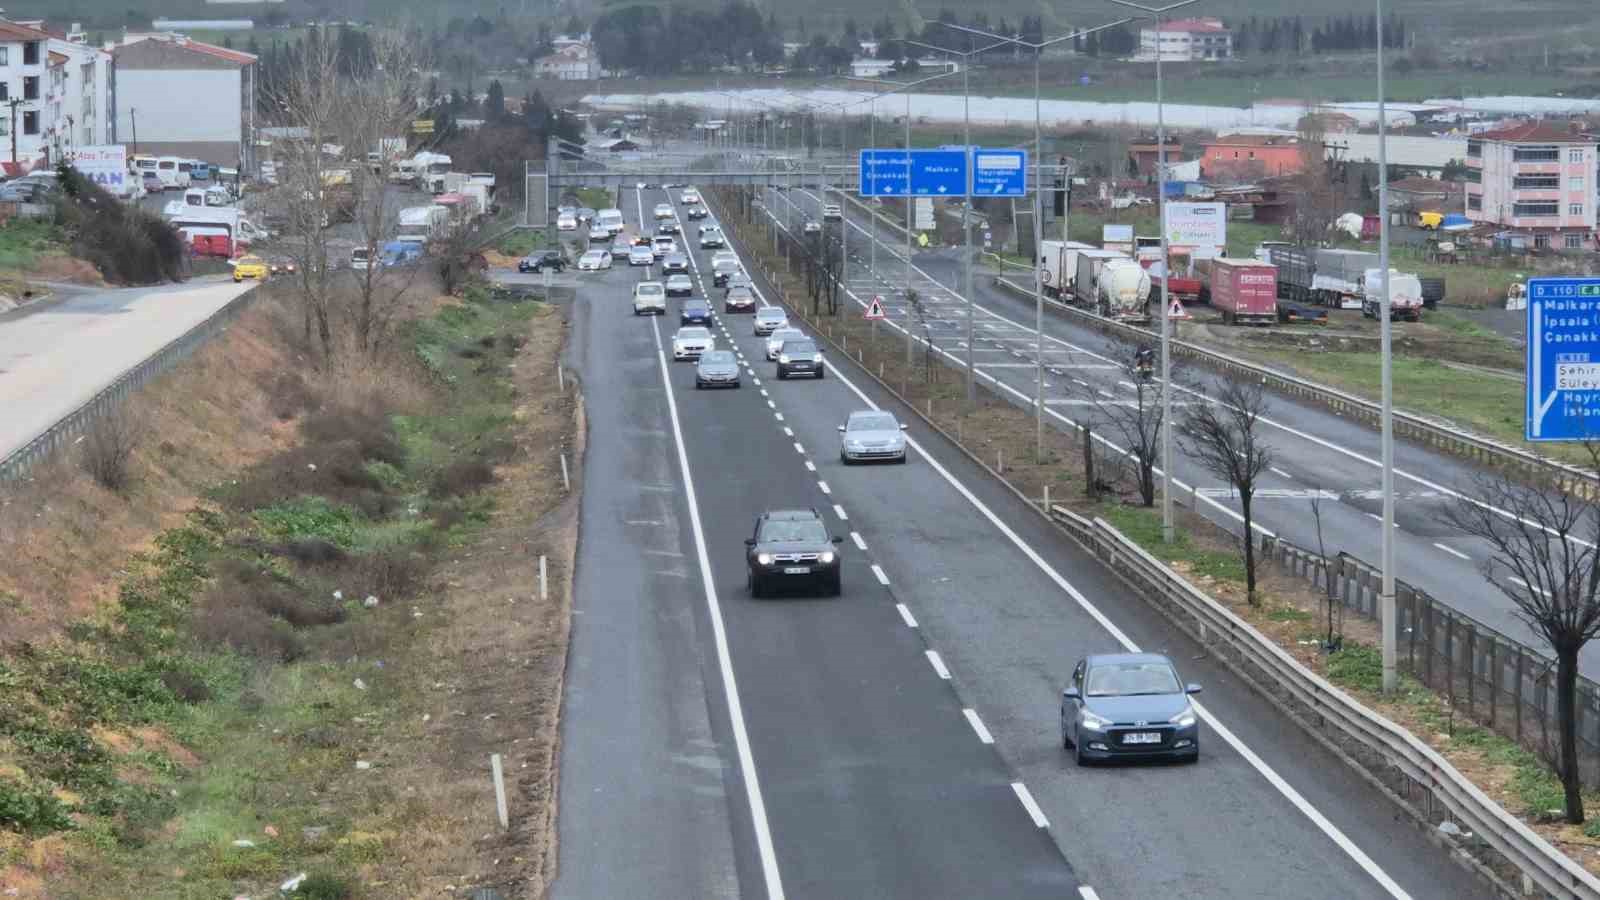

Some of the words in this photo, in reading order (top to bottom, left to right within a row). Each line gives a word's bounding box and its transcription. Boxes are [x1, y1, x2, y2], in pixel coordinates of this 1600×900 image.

[1537, 287, 1545, 296] D
[1554, 286, 1573, 295] 110
[1563, 392, 1600, 405] Hayr
